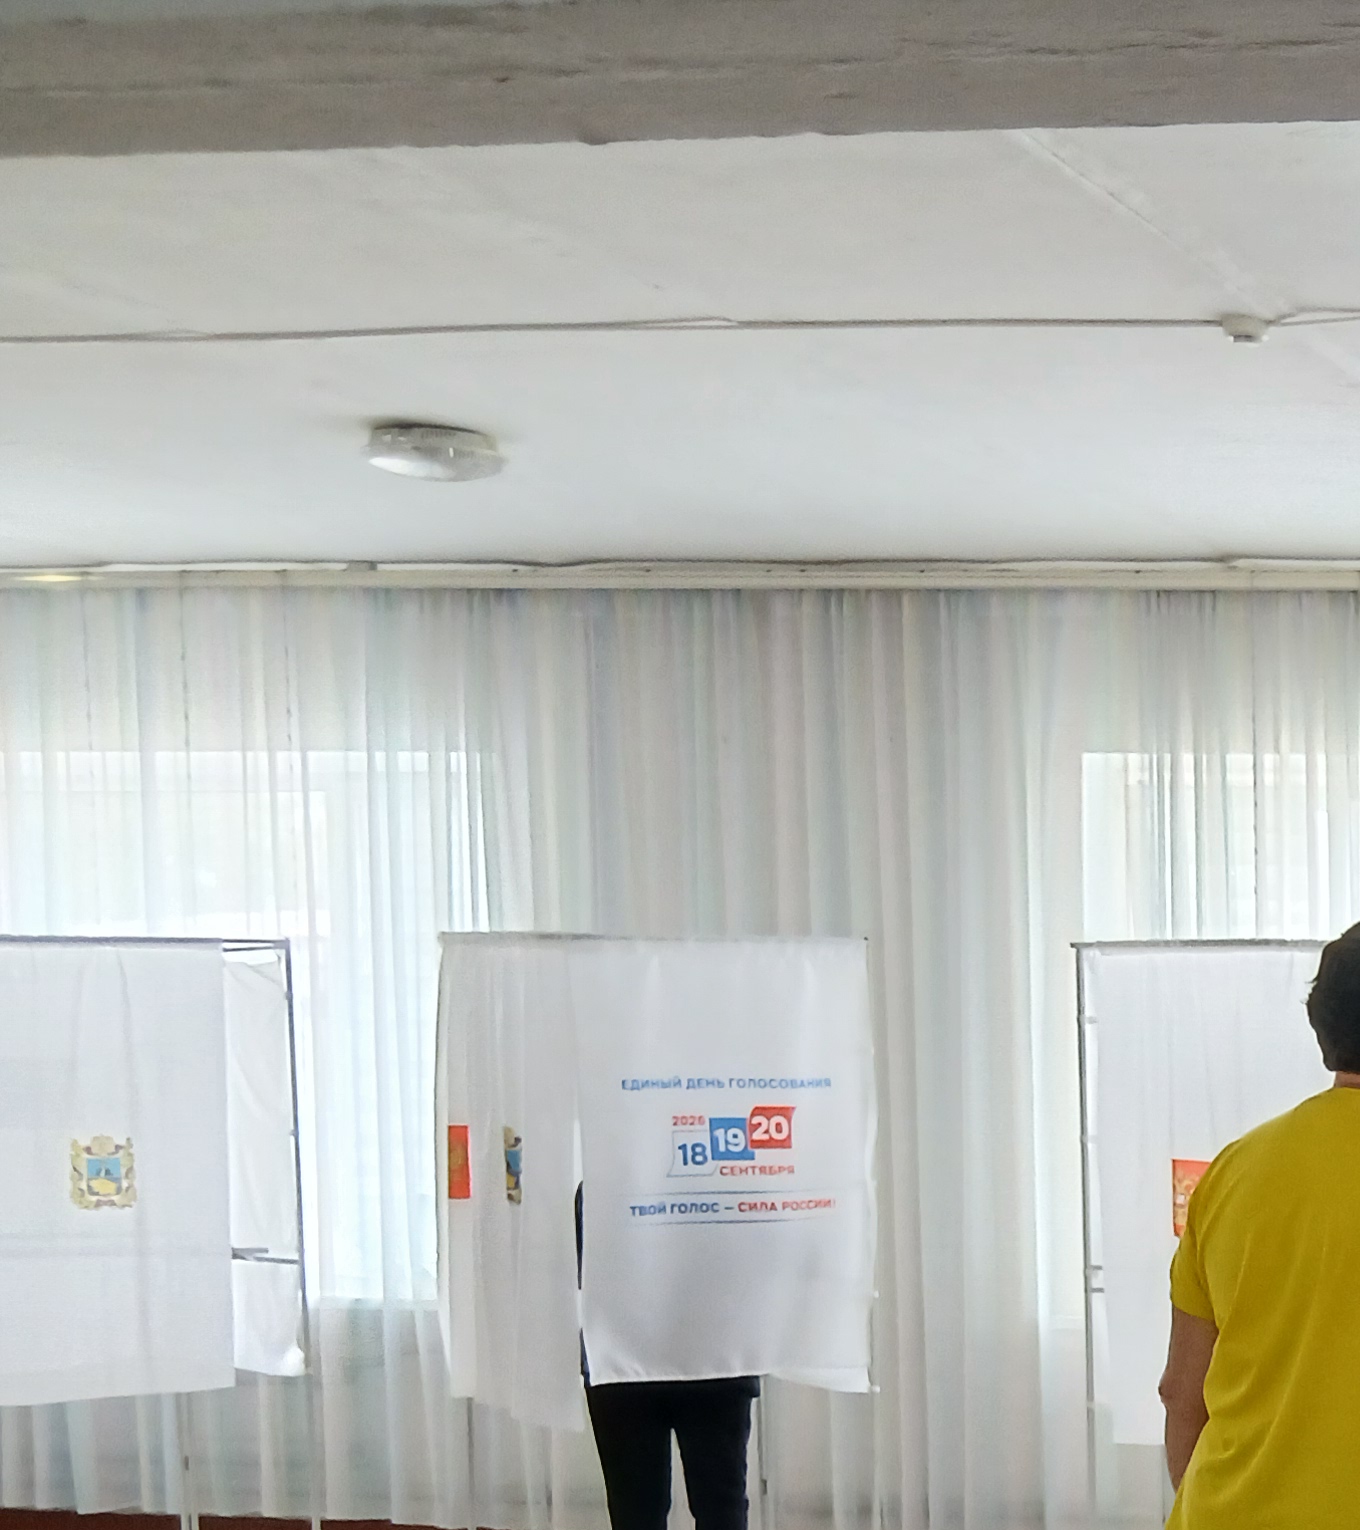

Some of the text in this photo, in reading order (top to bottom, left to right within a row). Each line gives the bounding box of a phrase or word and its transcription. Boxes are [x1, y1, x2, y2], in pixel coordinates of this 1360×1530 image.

[621, 1075, 832, 1091] ЕДИНЫЙ ДЕНЬ ГОЛОСОВАНИЯ
[672, 1115, 706, 1126] 2026
[678, 1115, 789, 1166] 18 19 20
[719, 1165, 795, 1176] СЕНТЯБРЯ
[630, 1202, 667, 1216] ТВОЙ
[670, 1202, 720, 1214] ГОЛОС
[738, 1202, 778, 1212] СИЛА
